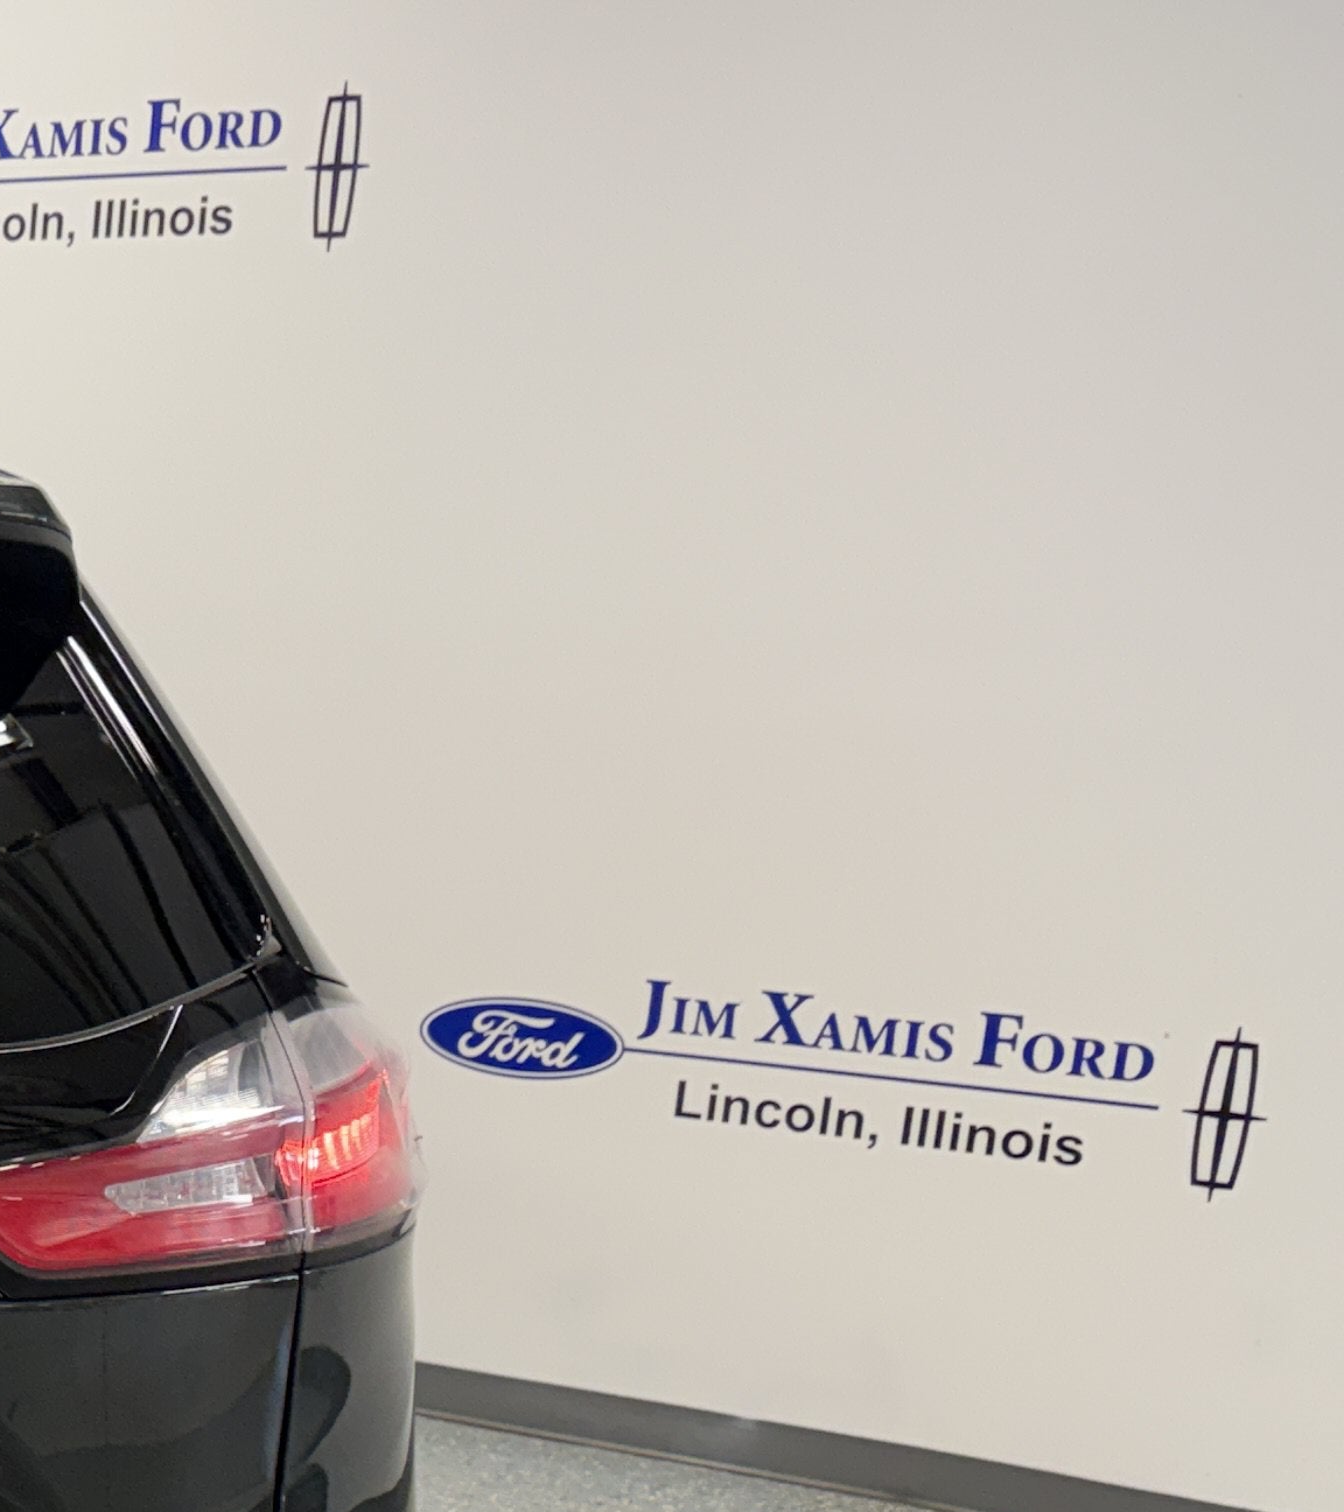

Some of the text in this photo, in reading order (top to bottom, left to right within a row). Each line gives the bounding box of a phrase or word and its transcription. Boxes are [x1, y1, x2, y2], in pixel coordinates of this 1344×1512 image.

[143, 98, 282, 153] FORD
[91, 197, 233, 239] Illinois
[457, 1009, 580, 1070] Ford
[638, 979, 1155, 1082] JIM XAMIS FORD
[674, 1081, 1084, 1166] Lincoln, Illinois
